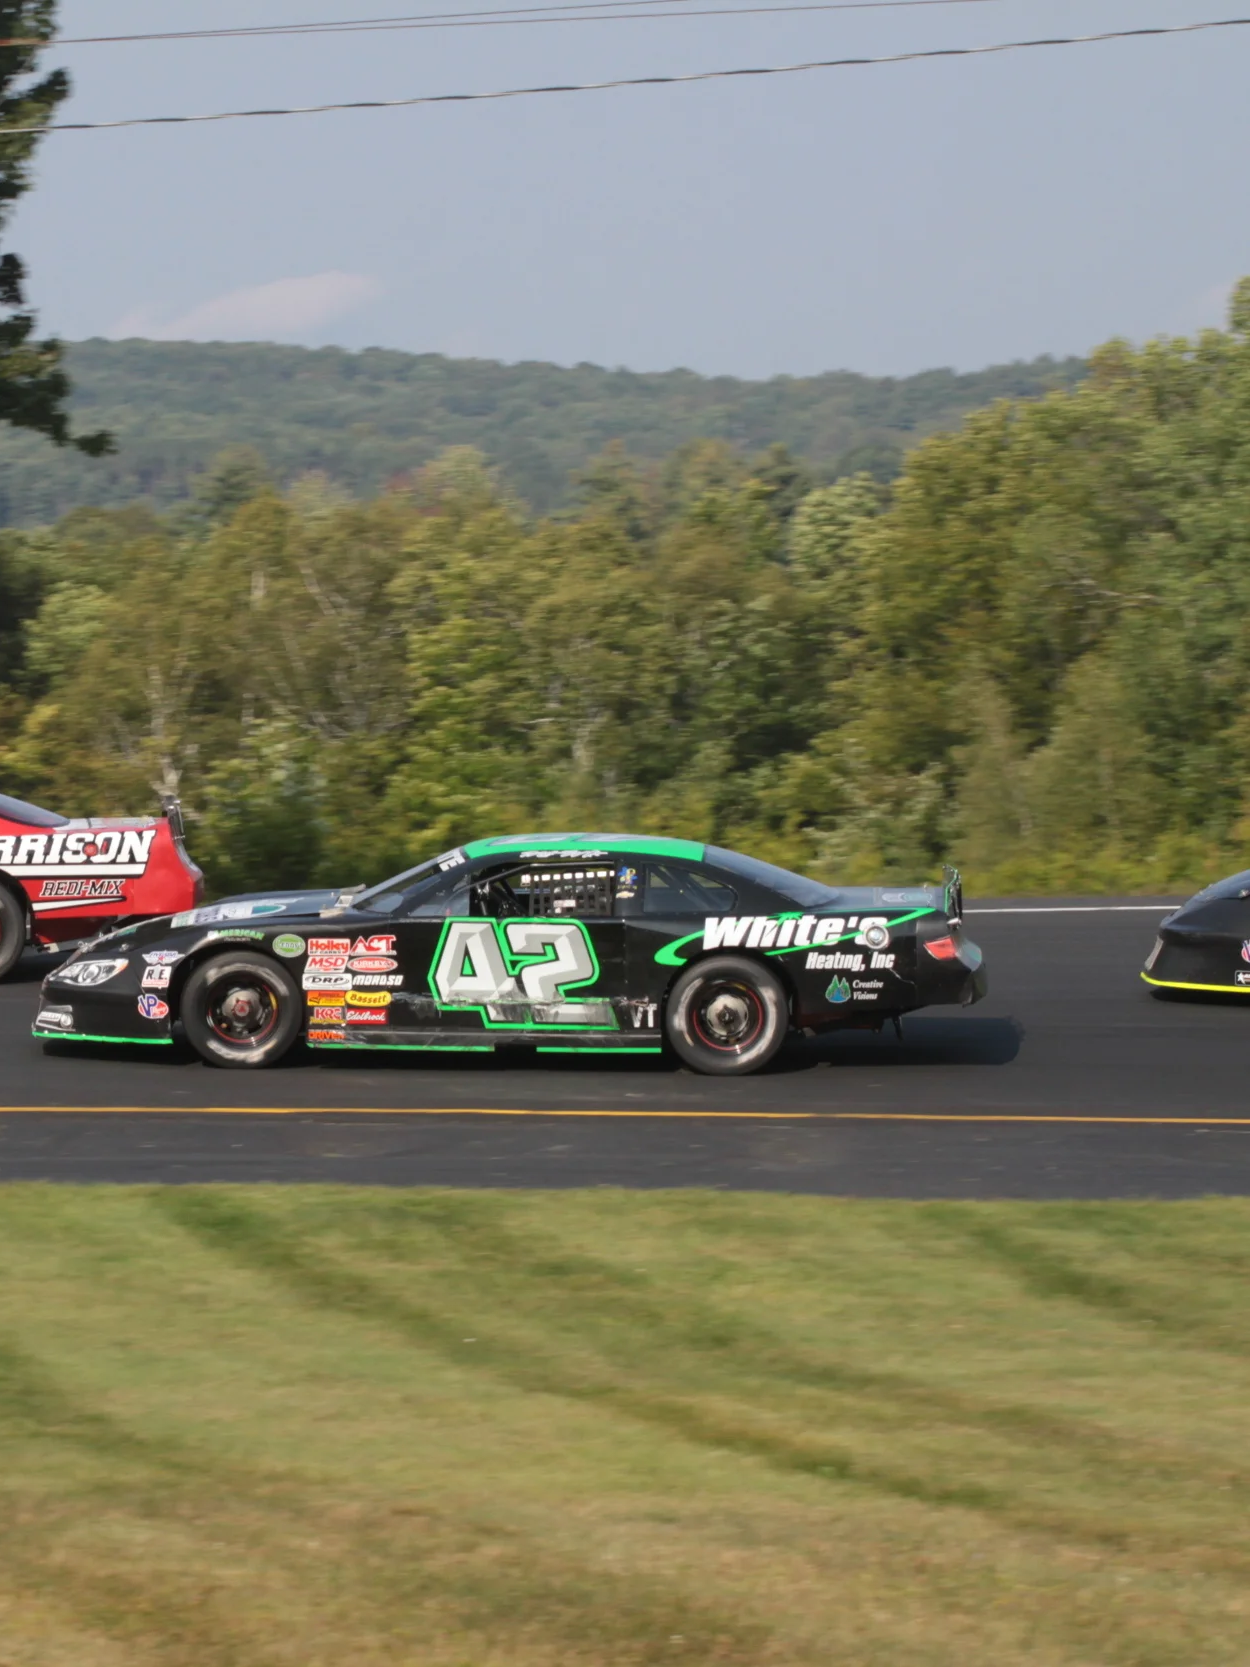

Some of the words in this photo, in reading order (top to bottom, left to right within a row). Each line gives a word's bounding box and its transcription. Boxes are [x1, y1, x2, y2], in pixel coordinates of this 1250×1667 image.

[40, 878, 127, 897] REDI-MIX
[213, 928, 264, 940] AMERICAN
[309, 940, 349, 954] Holley
[350, 935, 396, 955] ACT
[308, 956, 346, 968] MSD
[805, 952, 866, 972] Heating,
[870, 952, 896, 969] Inc
[146, 968, 168, 980] R.E.
[429, 919, 618, 1027] 42
[352, 975, 404, 986] MOROSO
[852, 979, 884, 989] Creative
[350, 993, 387, 1004] Bassett
[852, 991, 878, 1001] Visions
[138, 994, 158, 1017] VP
[315, 1007, 342, 1020] KRC
[346, 1010, 386, 1021] Edelbrock
[631, 1003, 658, 1029] VT
[308, 1031, 345, 1041] DRIVEN
